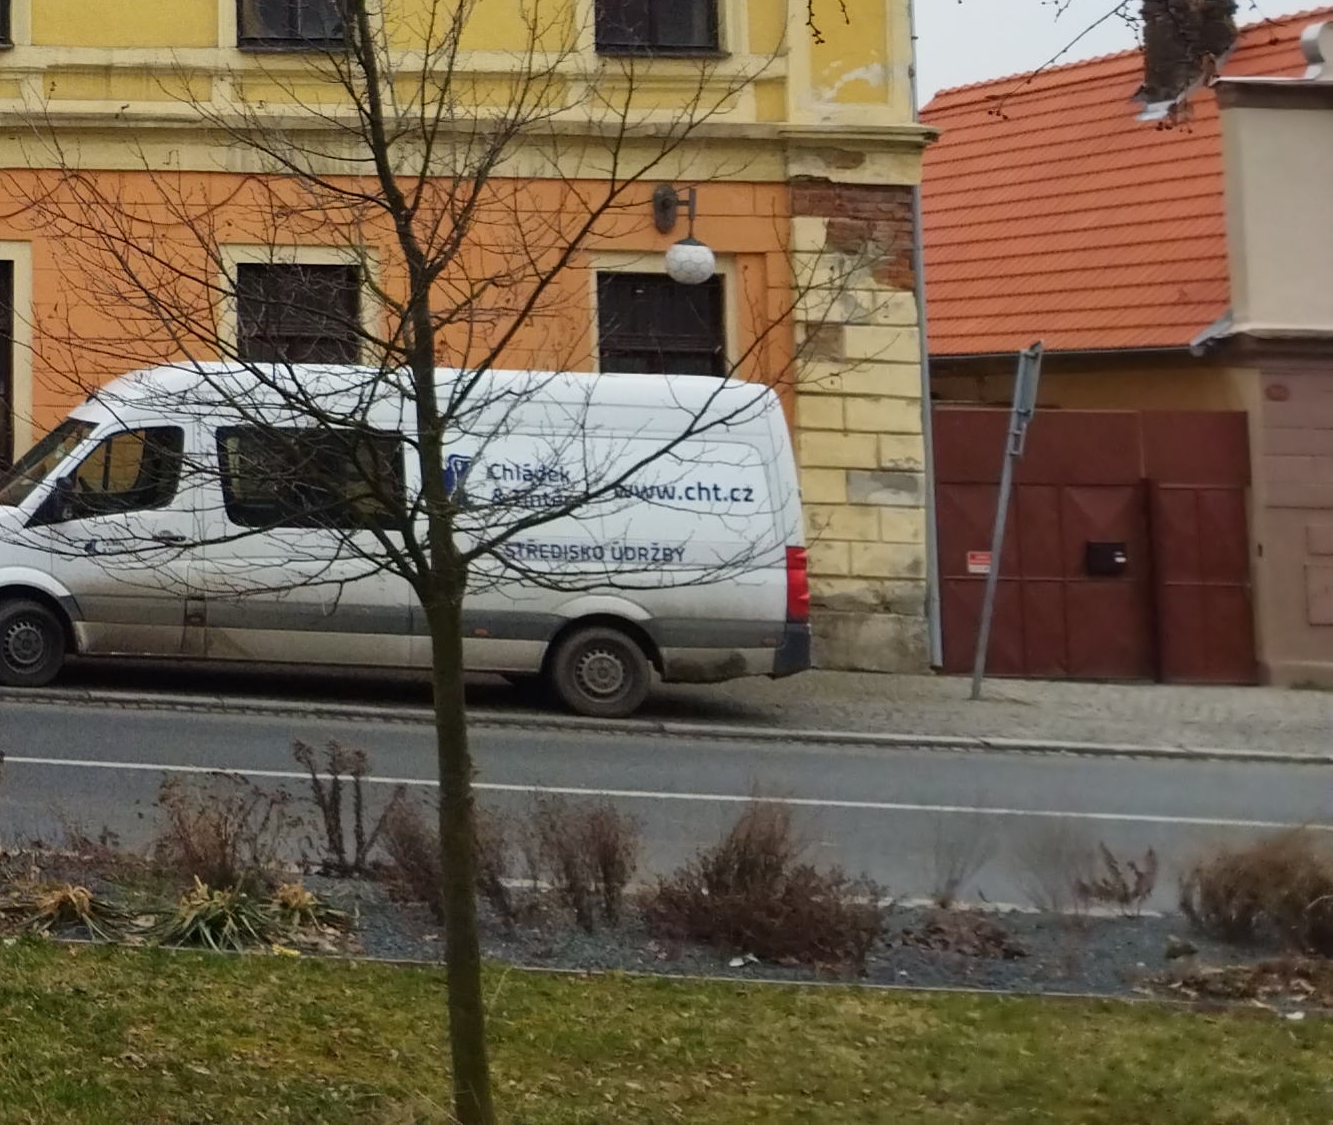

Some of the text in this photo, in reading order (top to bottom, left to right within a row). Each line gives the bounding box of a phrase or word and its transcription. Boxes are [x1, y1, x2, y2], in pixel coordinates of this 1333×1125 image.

[490, 463, 570, 484] Chládek
[614, 481, 755, 503] www.cht.cz
[504, 539, 685, 563] STŘEDISKO ÚDRŽBY
